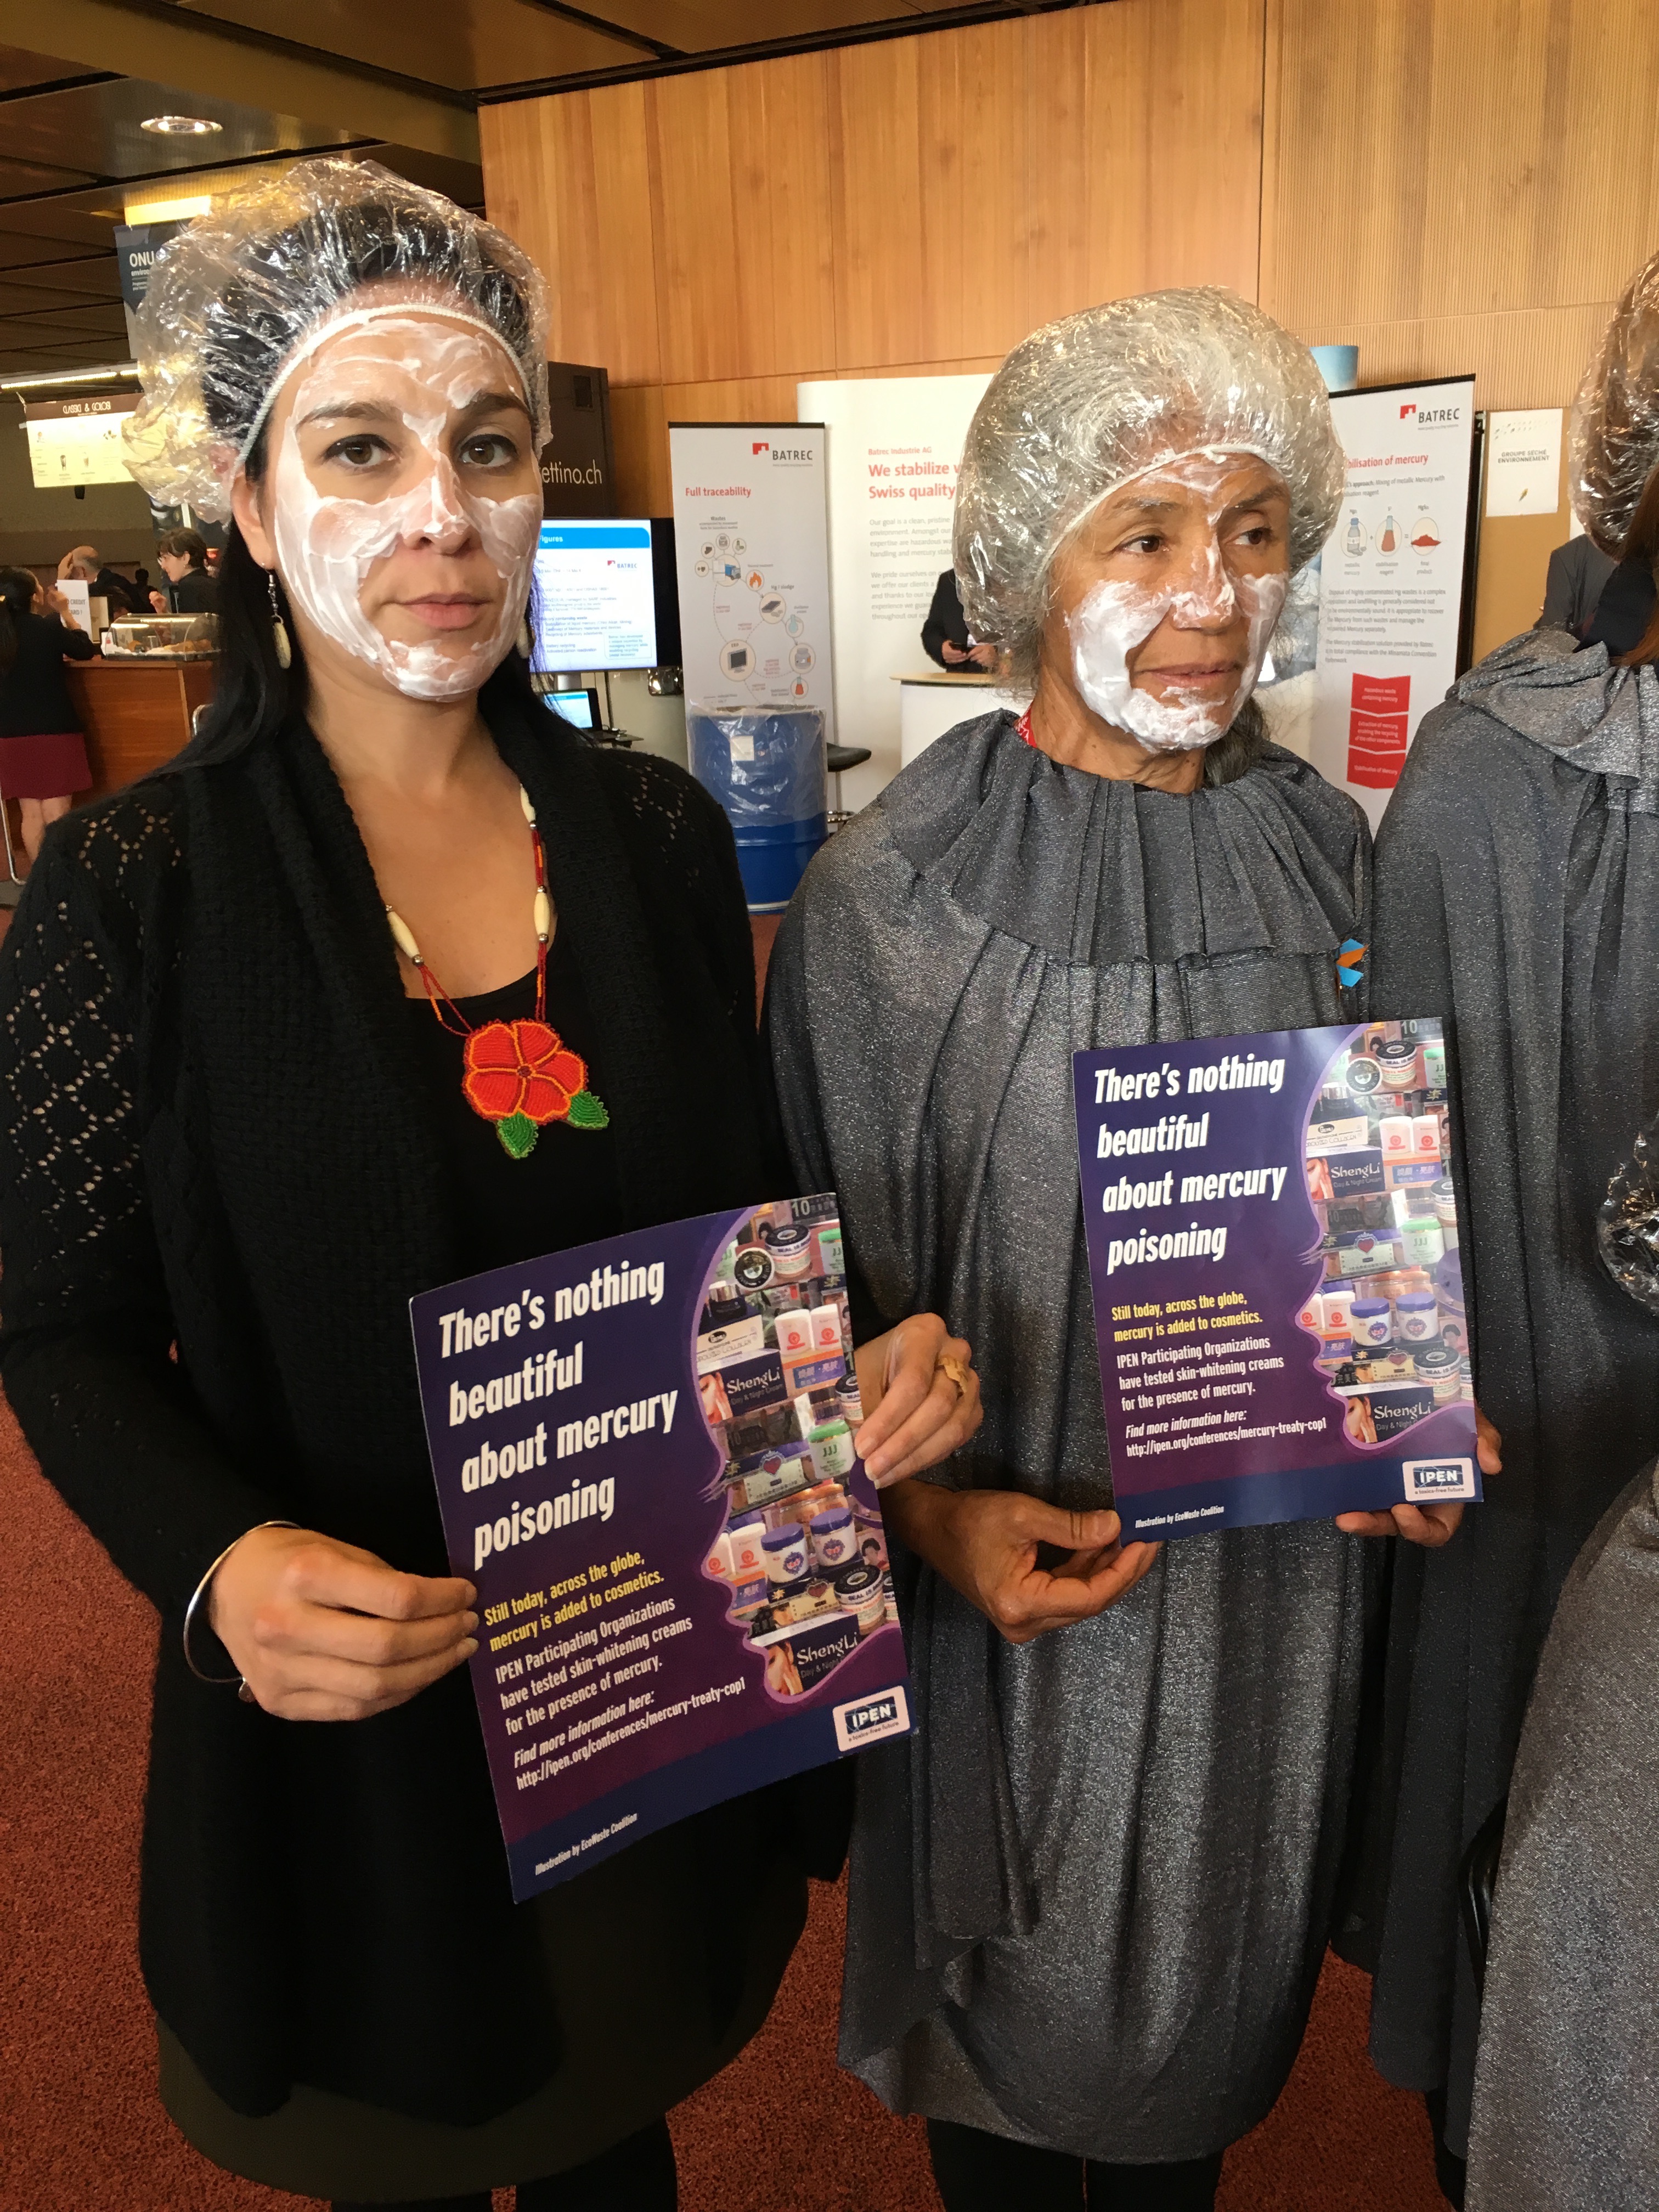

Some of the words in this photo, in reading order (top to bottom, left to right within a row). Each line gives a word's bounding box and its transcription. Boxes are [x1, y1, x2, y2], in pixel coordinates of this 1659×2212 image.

[129, 250, 154, 267] ONU
[1418, 408, 1460, 423] BATREC
[772, 450, 812, 460] BATREC
[891, 447, 920, 455] Industrie
[1385, 455, 1394, 466] of
[1395, 454, 1429, 465] mercury
[1498, 455, 1550, 464] ENVIRONNEMENT
[540, 459, 602, 484] ettino.ch
[868, 464, 891, 477] We
[895, 461, 949, 476] stabilize
[685, 487, 701, 496] Full
[703, 486, 751, 498] traceability
[868, 485, 905, 499] Swiss
[909, 483, 956, 501] quality
[1402, 1020, 1418, 1035] 10
[1095, 1063, 1180, 1103] There's
[1187, 1053, 1285, 1093] nothing
[1097, 1111, 1210, 1158] beautiful
[1330, 1162, 1380, 1178] ShengLi
[1102, 1170, 1173, 1214] about
[1180, 1166, 1288, 1203] mercury
[791, 1199, 811, 1217] 10
[1107, 1222, 1227, 1276] poisoning
[439, 1289, 545, 1358] There's
[555, 1260, 664, 1323] nothing
[1111, 1305, 1131, 1321] Still
[1133, 1302, 1163, 1318] today,
[1165, 1299, 1197, 1314] across
[1199, 1294, 1215, 1309] the
[1217, 1290, 1248, 1310] globe,
[1114, 1326, 1153, 1342] mercury
[1155, 1322, 1165, 1336] is
[1167, 1317, 1196, 1335] added
[1198, 1316, 1209, 1330] to
[1210, 1310, 1263, 1329] cosmetics.
[1116, 1352, 1139, 1369] IPEN
[1141, 1344, 1203, 1365] Participating
[1204, 1336, 1271, 1358] Organizations
[449, 1340, 583, 1427] beautiful
[726, 1366, 781, 1394] ShengLi
[1119, 1376, 1142, 1390] have
[1143, 1368, 1175, 1386] tested
[1176, 1359, 1246, 1381] skin-whitening
[1248, 1357, 1285, 1371] creams
[1121, 1397, 1136, 1412] for
[1137, 1393, 1154, 1409] the
[1156, 1389, 1198, 1409] presence
[1201, 1383, 1211, 1399] of
[1213, 1381, 1256, 1397] mercury.
[1374, 1401, 1431, 1420] ShengLi
[1126, 1423, 1145, 1438] Find
[1146, 1421, 1169, 1435] more
[1171, 1412, 1222, 1431] information
[1223, 1409, 1248, 1423] here:
[1126, 1417, 1327, 1458] http://ipen.org/conferences/mercury-treaty-cop1
[461, 1421, 548, 1493] about
[556, 1390, 678, 1459] mercury
[1420, 1470, 1458, 1483] IPEN
[474, 1476, 615, 1571] poisoning
[1135, 1515, 1166, 1528] Illustration
[1167, 1514, 1173, 1525] by
[1175, 1509, 1200, 1522] EcoWaste
[1200, 1505, 1224, 1517] Coalition
[484, 1601, 510, 1626] Still
[511, 1590, 548, 1615] today,
[550, 1573, 588, 1599] across
[589, 1564, 608, 1582] the
[610, 1551, 645, 1577] globe,
[489, 1620, 538, 1652] mercury
[540, 1613, 552, 1630] is
[554, 1595, 588, 1624] added
[589, 1592, 602, 1609] to
[605, 1571, 664, 1602] cosmetics.
[495, 1658, 523, 1684] IPEN
[525, 1628, 599, 1671] Participating
[600, 1598, 675, 1638] Organizations
[797, 1632, 858, 1665] ShengLi
[500, 1687, 529, 1710] have
[531, 1665, 568, 1696] tested
[569, 1633, 650, 1678] skin-whitening
[652, 1617, 693, 1643] creams
[505, 1716, 523, 1736] for
[526, 1707, 546, 1726] the
[548, 1683, 597, 1720] presence
[600, 1672, 611, 1691] of
[613, 1655, 662, 1685] mercury.
[514, 1743, 537, 1769] Find
[539, 1733, 566, 1757] more
[568, 1703, 626, 1742] information
[629, 1690, 654, 1712] here:
[852, 1703, 891, 1728] IPEN
[516, 1676, 746, 1791] http://ipen.org/conferences/mercury-treaty-cop1
[535, 1849, 571, 1876] Illustration
[572, 1844, 580, 1857] by
[581, 1828, 610, 1851] EcoWaste
[611, 1812, 637, 1835] Coalition
